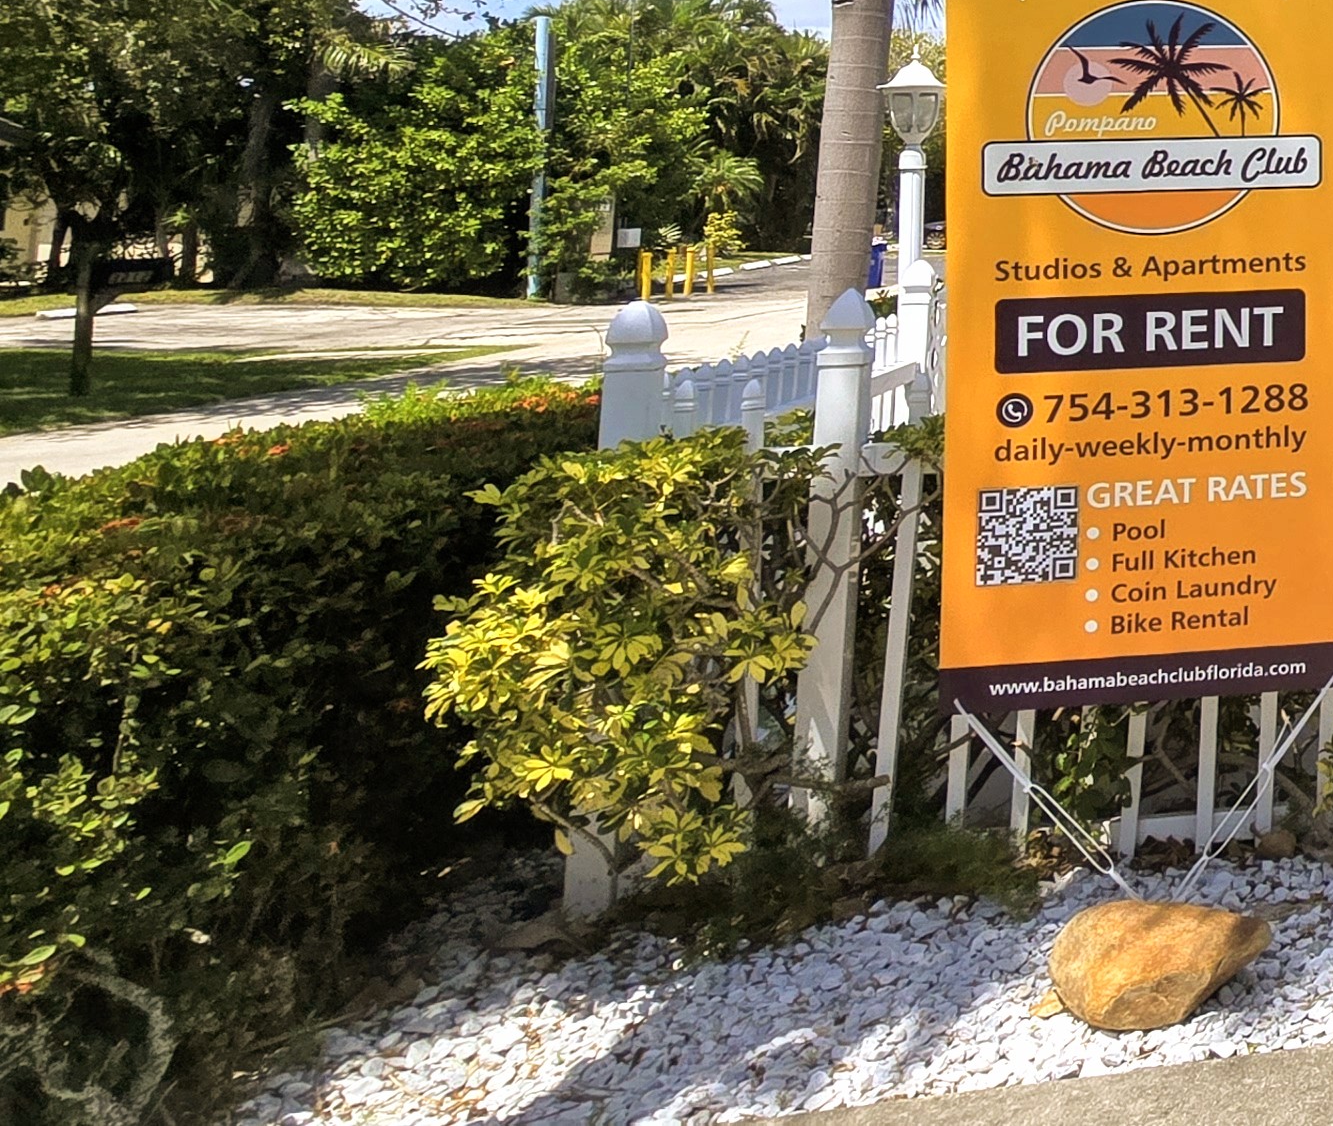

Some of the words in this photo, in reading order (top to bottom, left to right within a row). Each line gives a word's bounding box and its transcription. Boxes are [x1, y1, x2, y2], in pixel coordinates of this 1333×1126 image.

[1044, 111, 1157, 138] Pompano
[997, 152, 1131, 183] Bahama
[1141, 148, 1232, 180] Beach
[1241, 147, 1308, 183] Club
[994, 258, 1101, 281] Studios
[1112, 256, 1132, 277] &
[1141, 252, 1306, 281] Apartments
[1016, 312, 1125, 357] FOR
[1145, 306, 1284, 352] RENT
[1043, 383, 1309, 423] 754-313-1288
[994, 425, 1307, 465] daily-weekly-monthly
[1086, 478, 1196, 509] GREAT
[1207, 472, 1307, 503] RATES
[1112, 520, 1166, 541] Pool
[1111, 551, 1154, 572] Full
[1164, 547, 1256, 569] Kitchen
[1110, 582, 1167, 603] Coin
[1176, 575, 1277, 600] Laundry
[1110, 613, 1162, 634] Bike
[1170, 606, 1249, 630] Rental
[989, 660, 1306, 696] www.bahamabeachclubflorida.com
